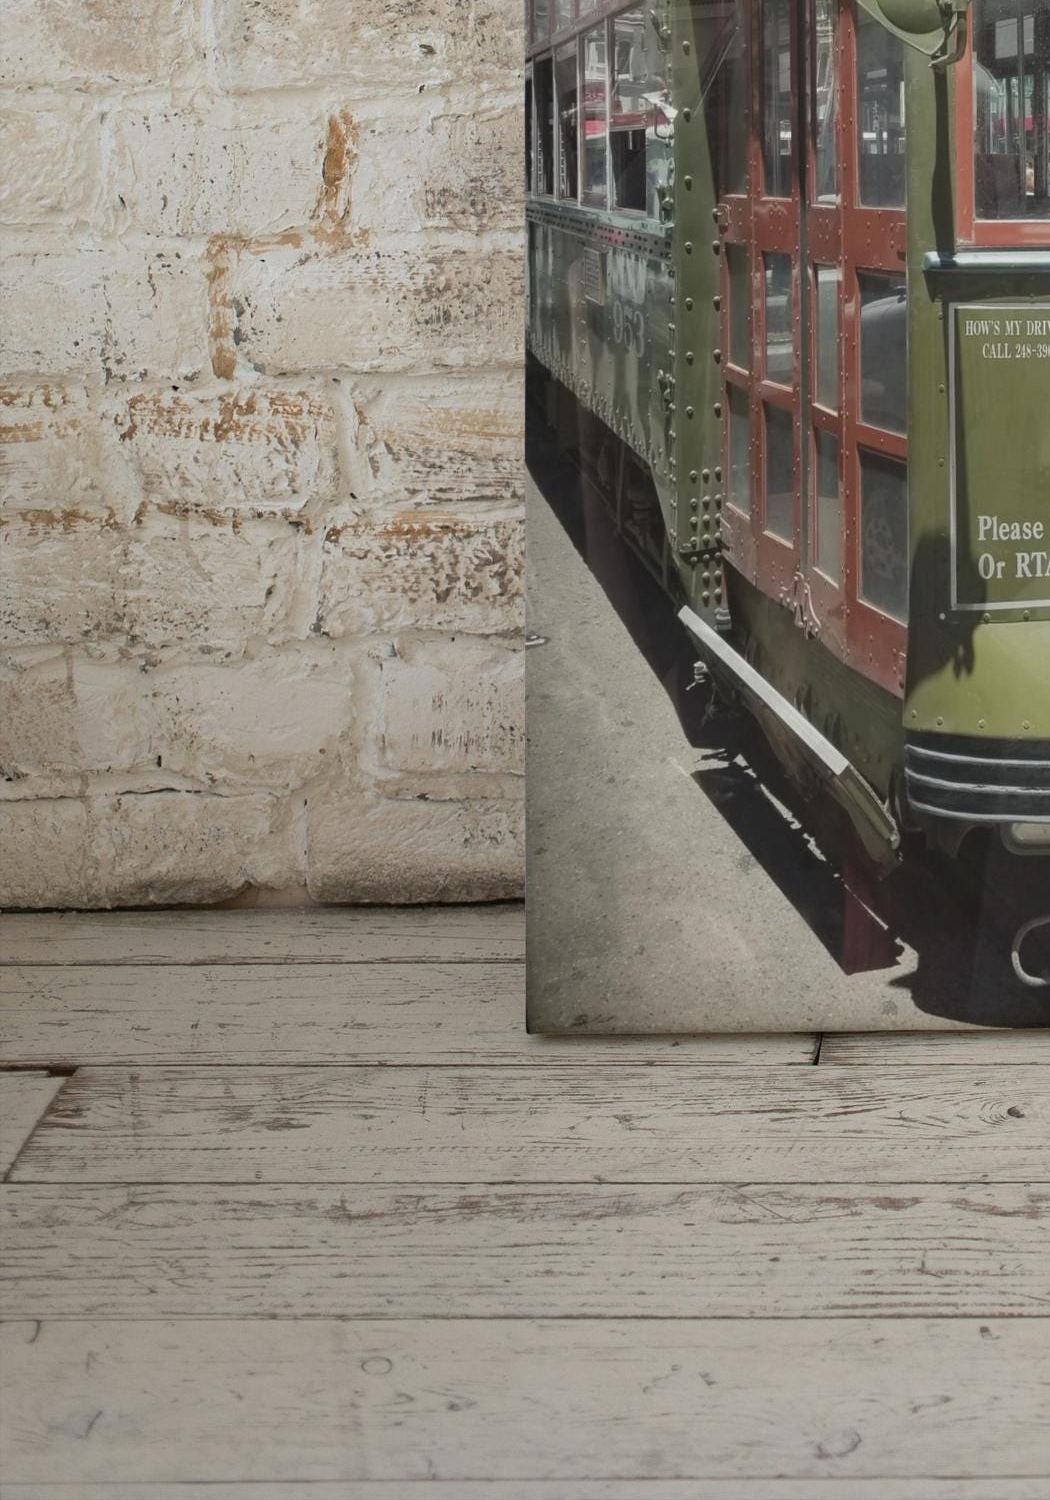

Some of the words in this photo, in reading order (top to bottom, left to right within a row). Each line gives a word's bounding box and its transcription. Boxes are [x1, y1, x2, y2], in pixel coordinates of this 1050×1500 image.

[965, 319, 1001, 336] HOW'S
[1004, 319, 1022, 336] MY
[982, 342, 1012, 359] CALL
[977, 514, 1044, 541] Please
[977, 552, 1006, 580] Or
